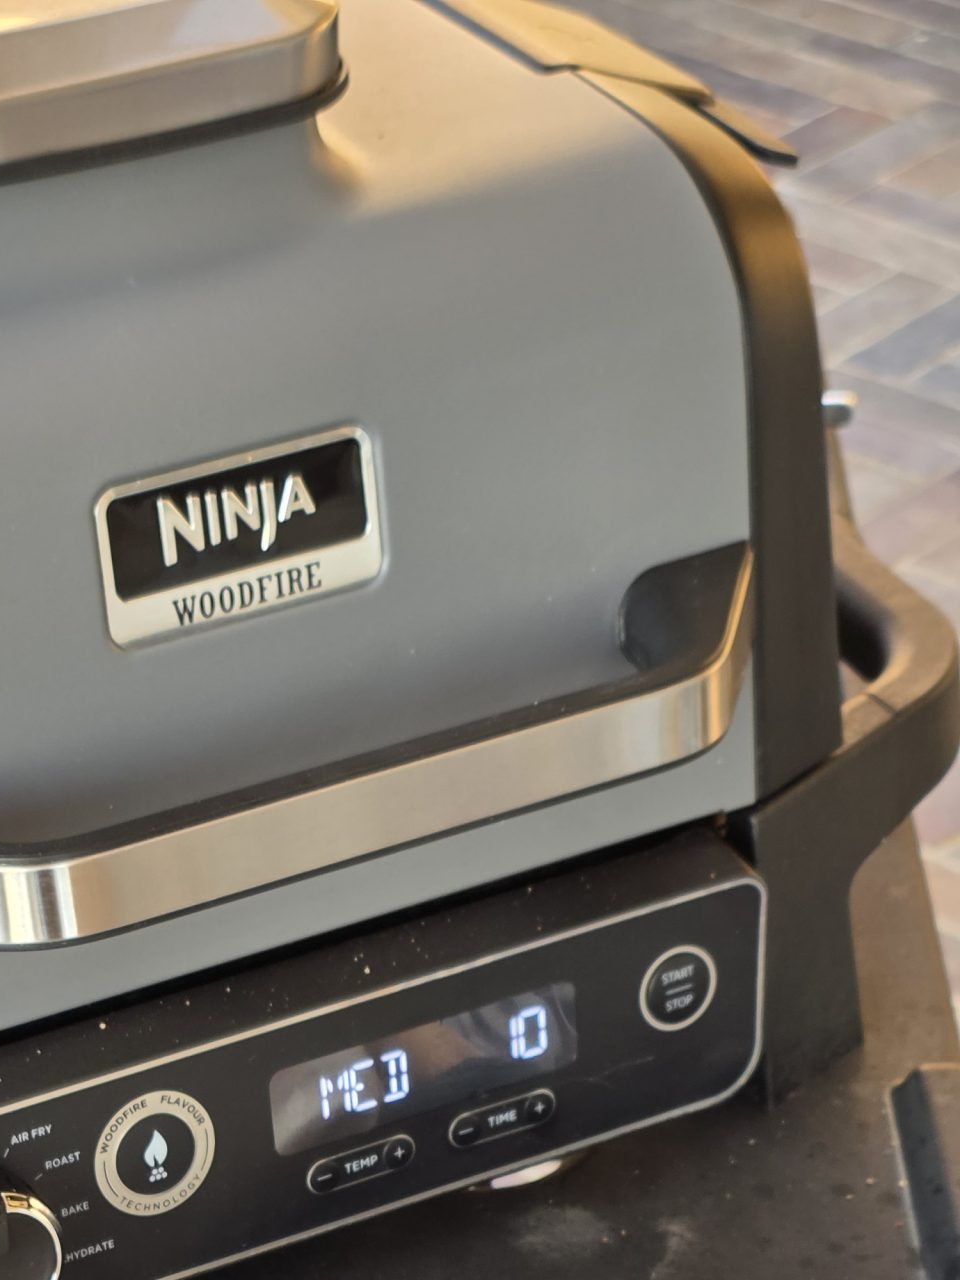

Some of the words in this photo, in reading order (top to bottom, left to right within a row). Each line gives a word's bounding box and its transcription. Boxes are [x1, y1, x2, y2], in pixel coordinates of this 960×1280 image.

[156, 472, 316, 568] NINJA
[172, 561, 322, 626] WOODFIRE
[661, 964, 695, 986] START
[665, 993, 694, 1013] STOP
[508, 1004, 548, 1061] 10
[319, 1048, 410, 1121] MED
[100, 1099, 148, 1154] WOODFIRE
[160, 1094, 205, 1126] FLAVOUR
[487, 1109, 517, 1129] TIME
[10, 1131, 30, 1146] AIR
[31, 1124, 52, 1139] FRY
[45, 1151, 80, 1170] ROAST
[344, 1154, 378, 1175] TEMP
[120, 1173, 200, 1211] TECHNOLOGY
[61, 1201, 90, 1217] BAKE
[64, 1239, 115, 1264] HYDRATE
